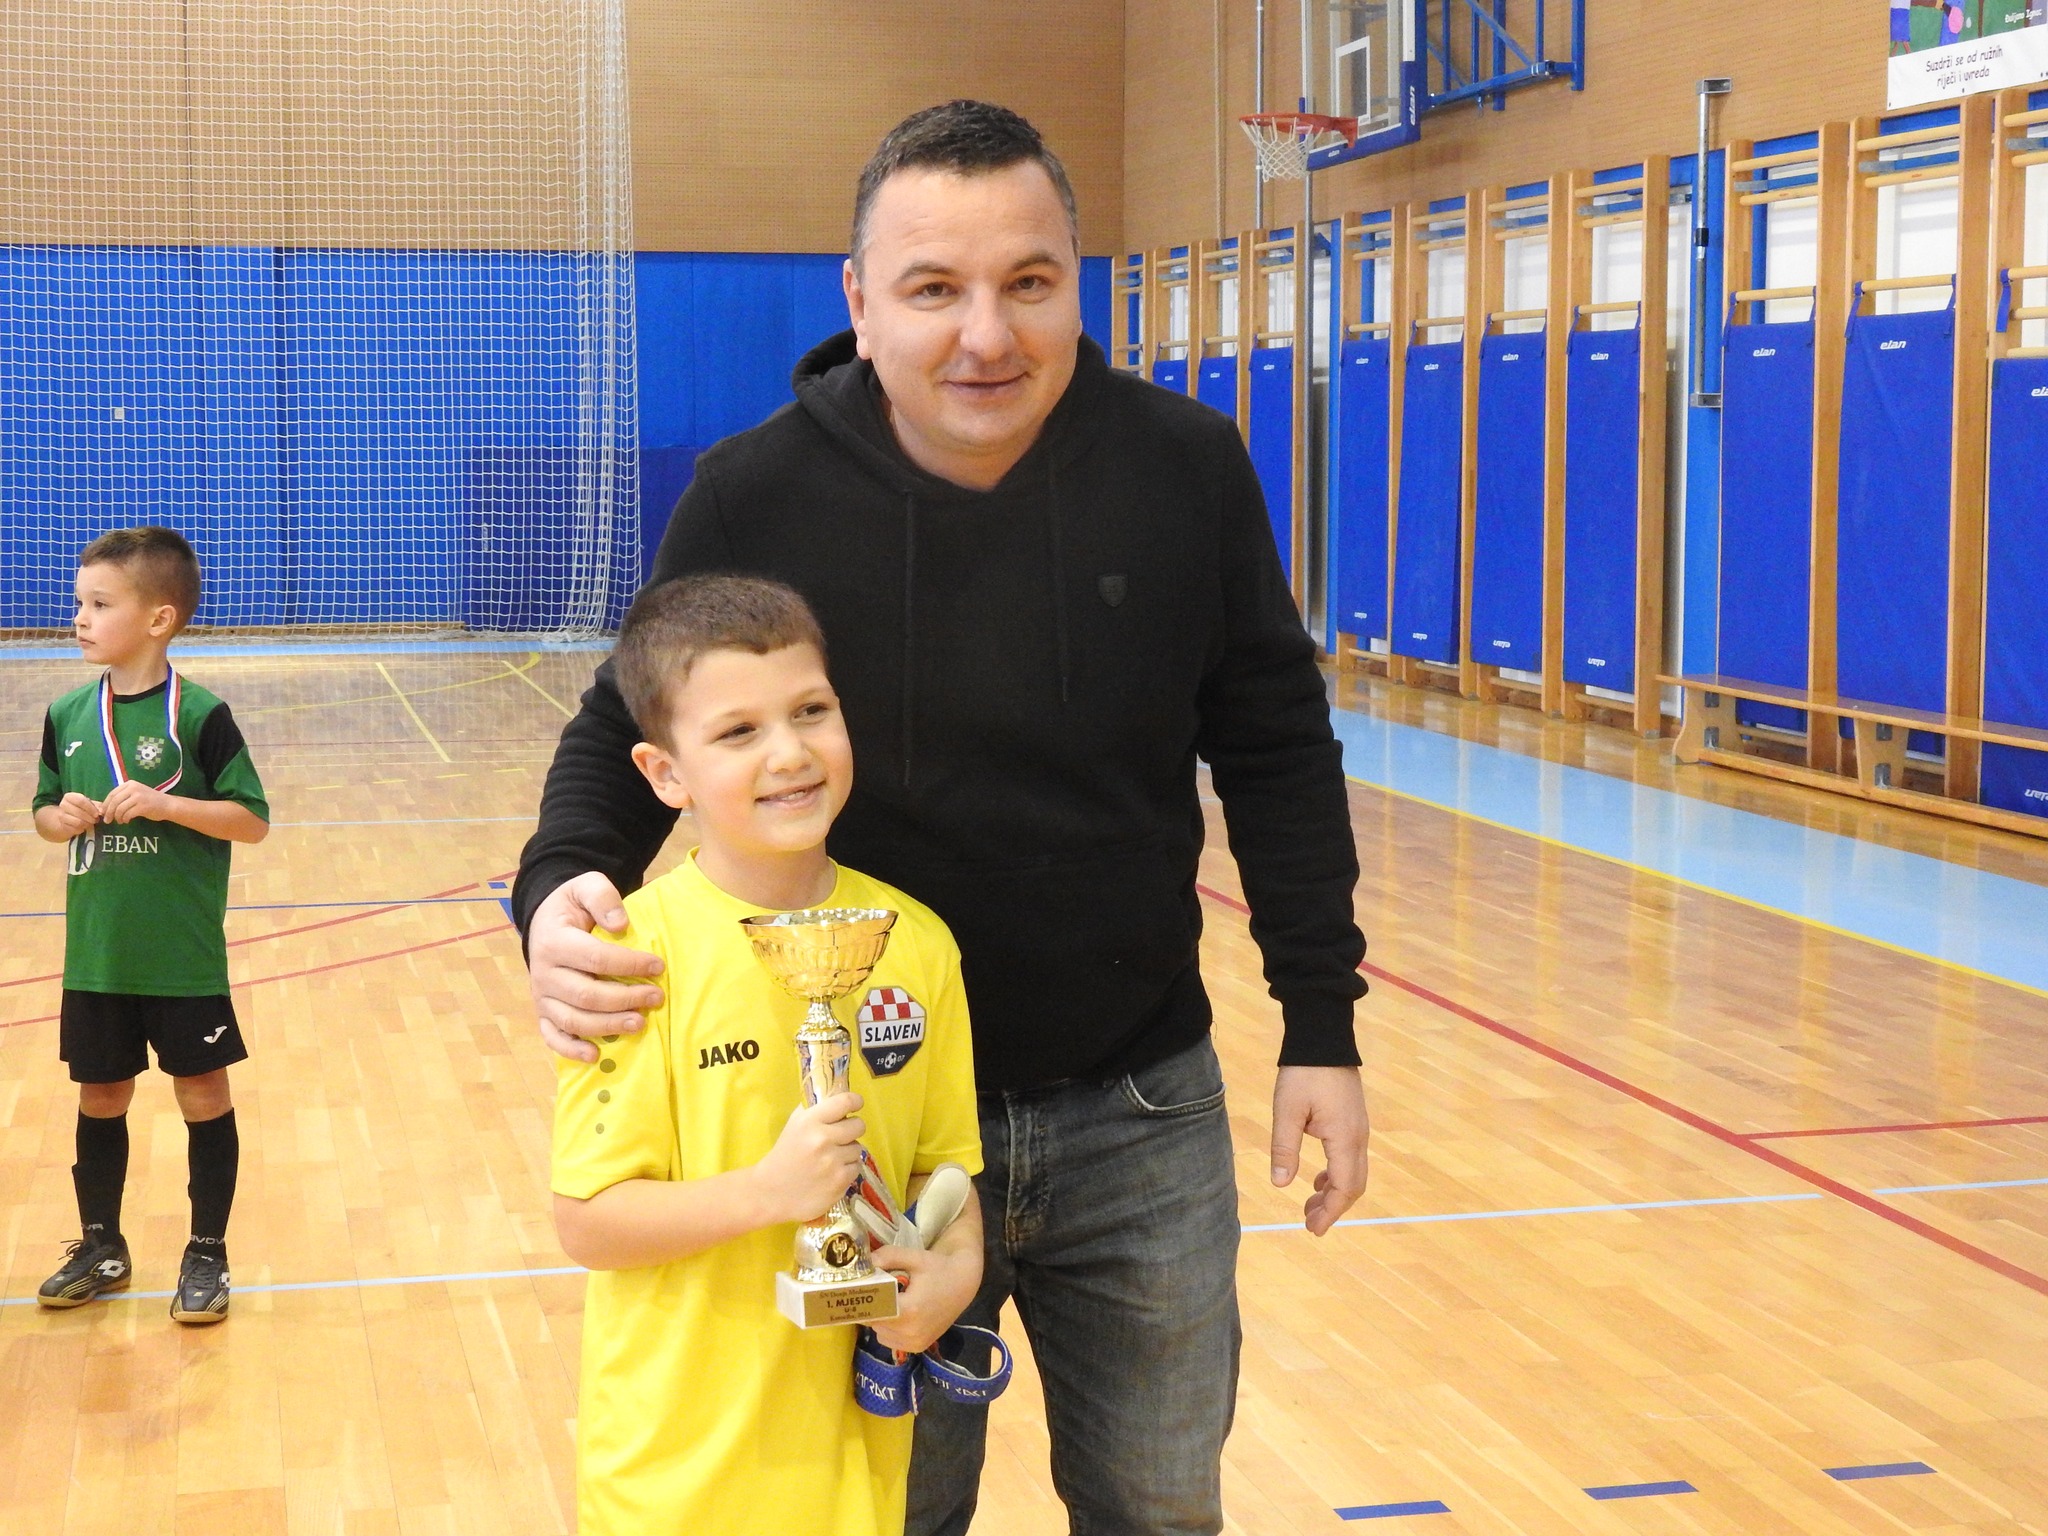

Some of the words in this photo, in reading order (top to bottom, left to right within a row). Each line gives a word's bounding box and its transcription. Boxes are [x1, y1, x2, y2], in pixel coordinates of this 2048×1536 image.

[1925, 55, 1953, 72] Suzdrži
[1955, 56, 1964, 66] se
[1966, 50, 1978, 64] od
[1753, 347, 1776, 357] elan
[1880, 340, 1907, 350] elan
[101, 834, 159, 854] EBAN
[864, 1022, 922, 1043] SLAVEN
[698, 1039, 760, 1070] JAKO
[827, 1300, 834, 1308] 1.
[835, 1295, 874, 1307] MJESTO
